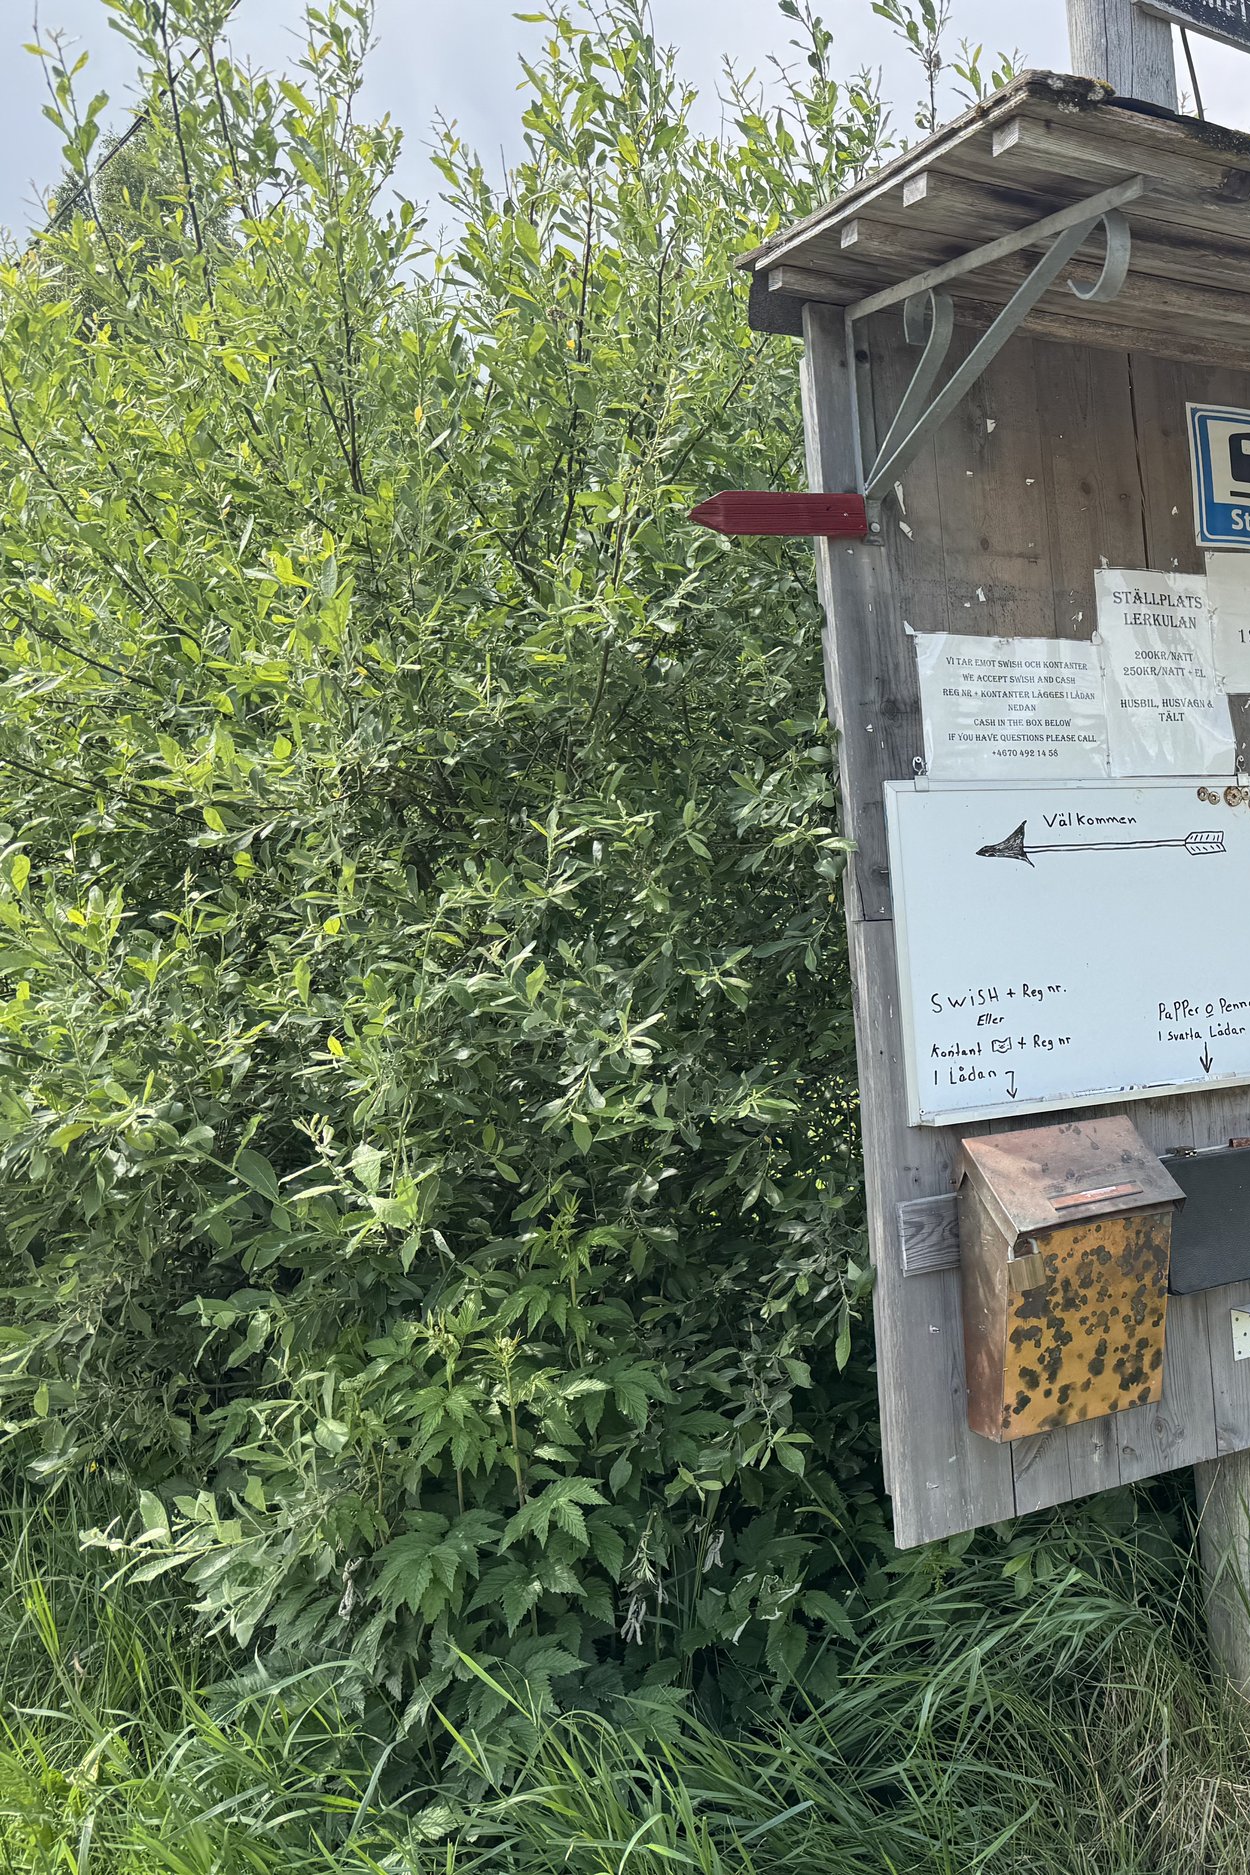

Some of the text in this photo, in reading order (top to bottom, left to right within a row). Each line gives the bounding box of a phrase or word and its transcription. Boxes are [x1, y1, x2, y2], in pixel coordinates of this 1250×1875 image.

[1112, 589, 1203, 609] STÄLLPLATS
[1124, 613, 1197, 630] LERKULAN
[997, 659, 1023, 669] SWISH
[1043, 660, 1088, 670] KONTANTER
[977, 674, 1008, 683] ACCEPT
[1009, 675, 1035, 684] SWISH
[1037, 676, 1054, 684] AND
[1055, 676, 1076, 684] CASH
[942, 688, 960, 697] REG
[980, 689, 1030, 698] KONTANTER
[1008, 704, 1036, 712] NEDAN
[1120, 698, 1160, 709] HUSBIL,
[1161, 697, 1205, 709] HUSVAGN
[1158, 710, 1185, 722] TÄLT
[973, 718, 1072, 727] CASH IN THE BOX BELOW
[957, 733, 974, 742] YOU
[975, 733, 998, 742] HAVE
[1000, 734, 1045, 742] QUESTIONS
[1045, 734, 1076, 743] PLEASE
[1077, 734, 1097, 743] CALL
[1022, 983, 1044, 1001] Reg
[977, 1013, 1005, 1026] Eller
[1167, 1027, 1202, 1041] Svarta
[931, 1041, 982, 1058] Kontant
[1033, 1034, 1054, 1051] Reg
[1058, 1036, 1071, 1045] nr
[950, 1065, 997, 1085] Lådan
